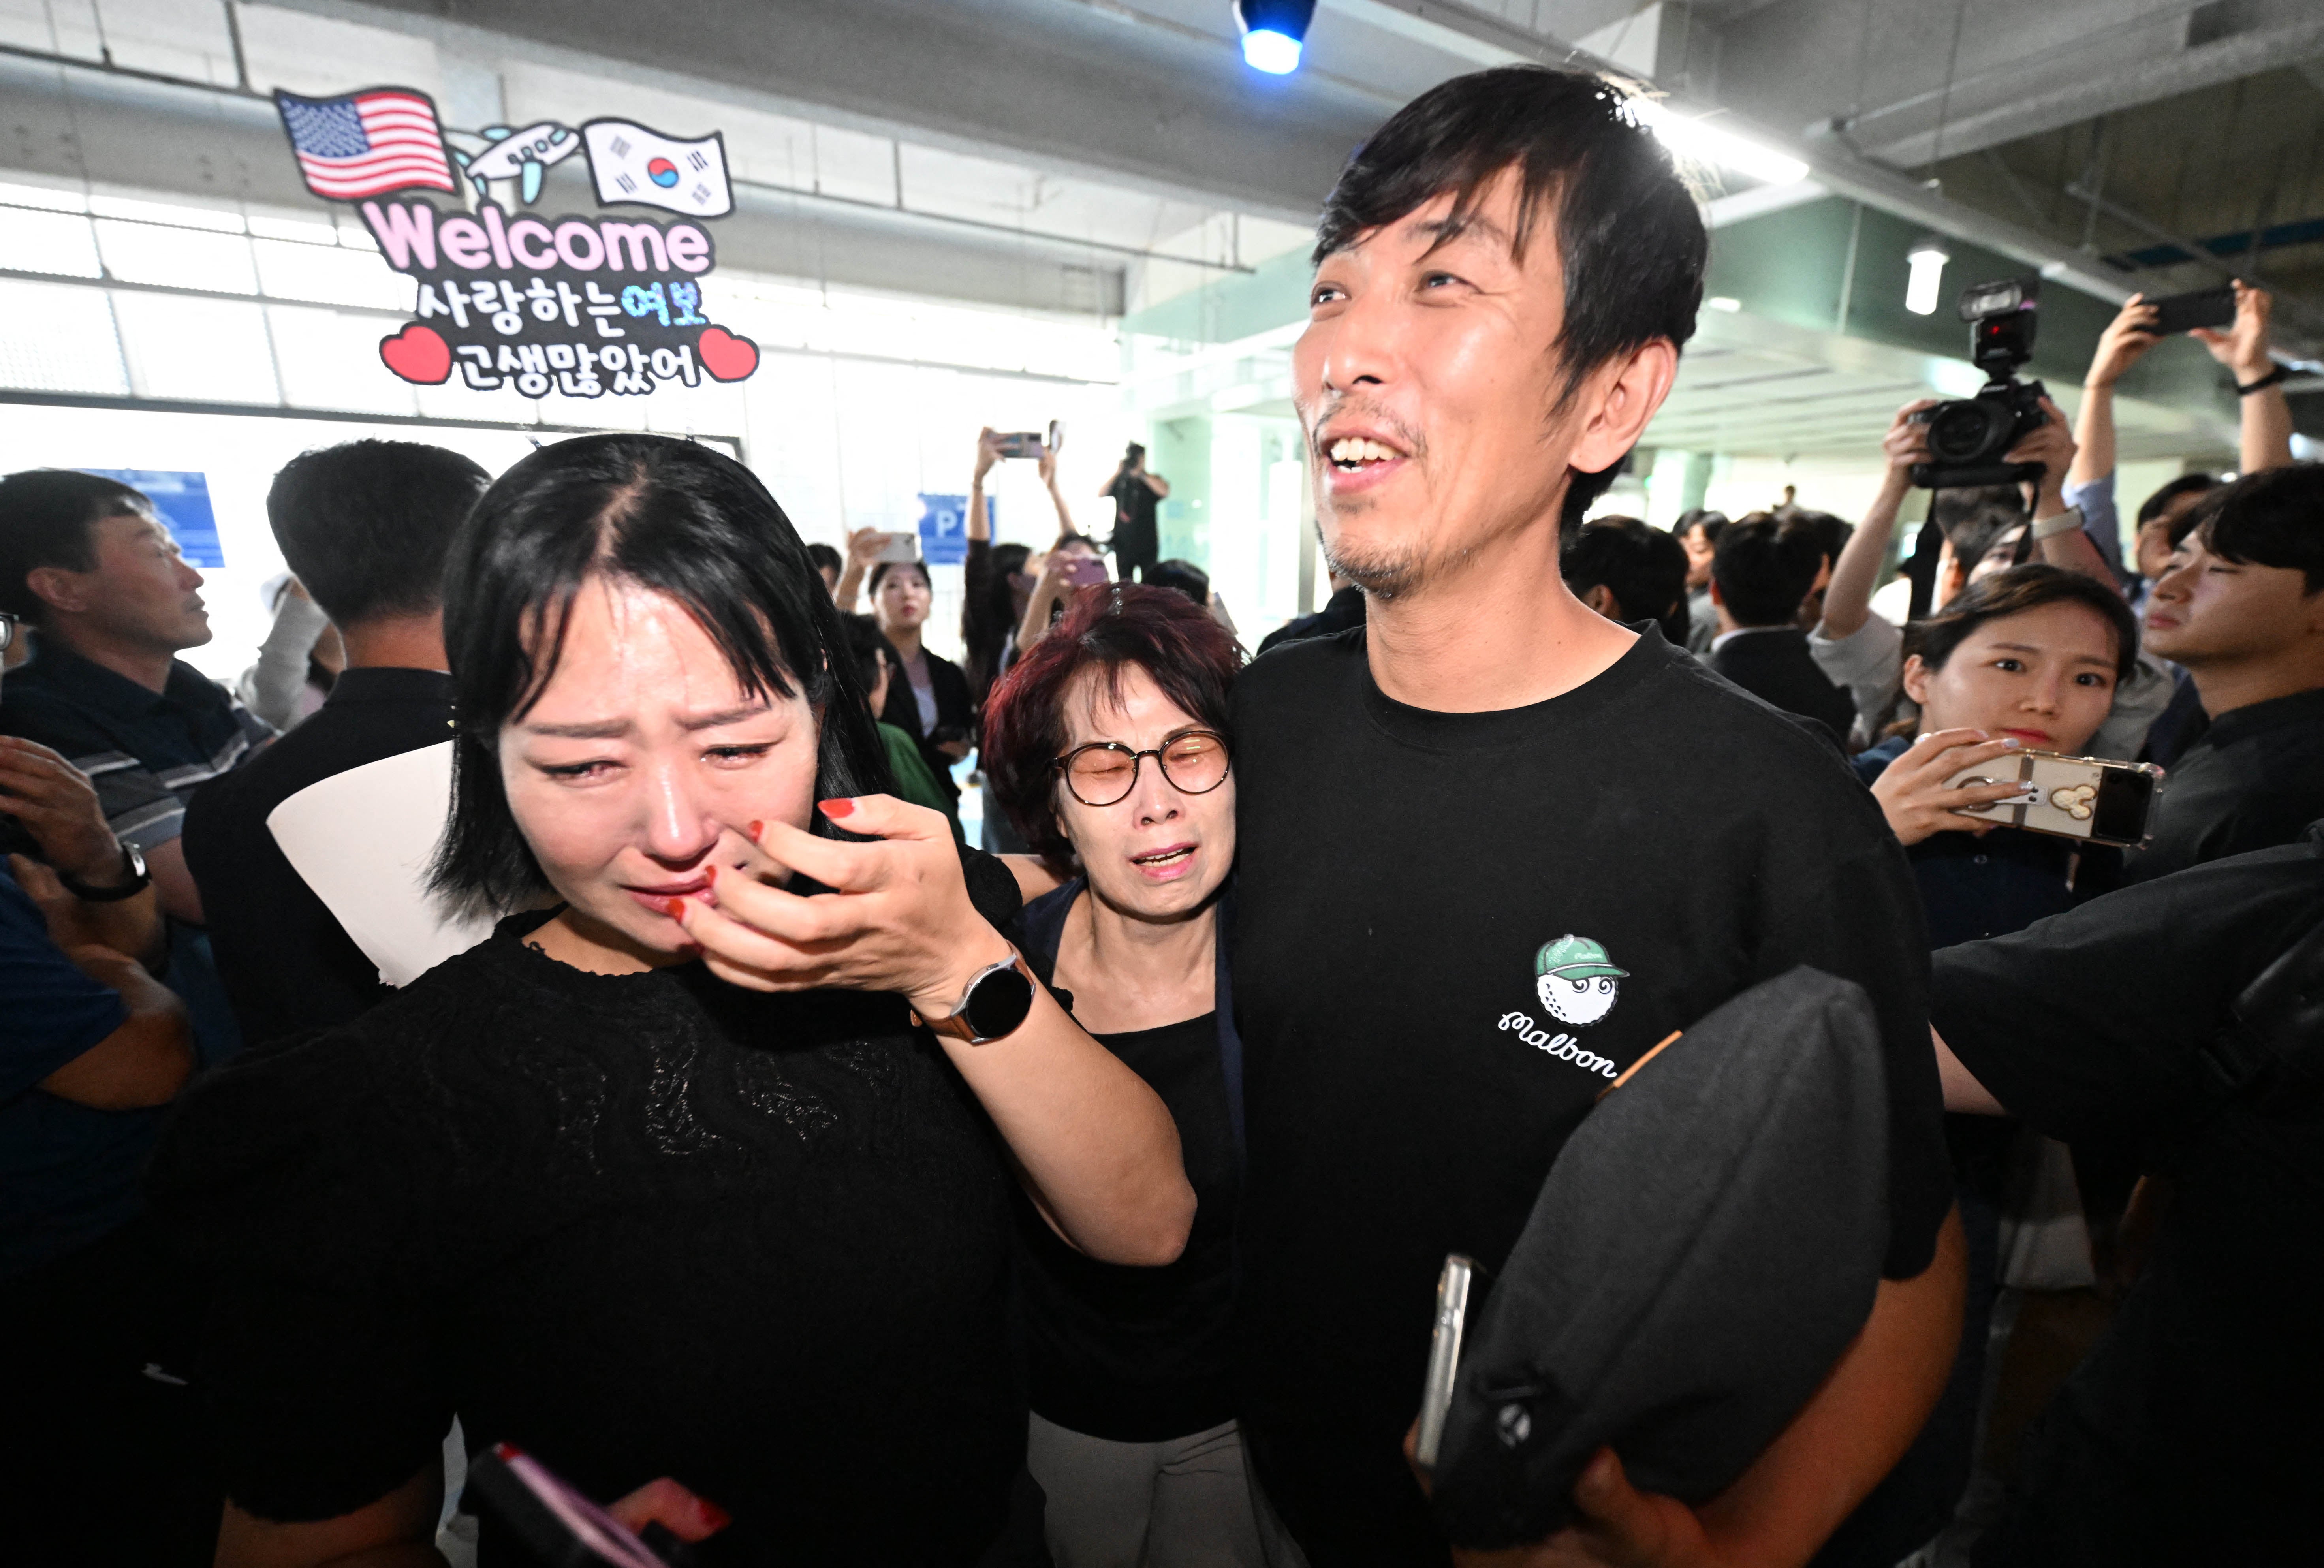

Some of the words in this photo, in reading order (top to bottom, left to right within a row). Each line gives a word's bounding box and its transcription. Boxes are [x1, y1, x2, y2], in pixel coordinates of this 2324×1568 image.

[362, 201, 710, 272] Welcome
[418, 277, 625, 338] 사랑하는
[621, 282, 706, 327] 여보
[937, 510, 958, 538] P
[1498, 1011, 1618, 1078] Malbon
